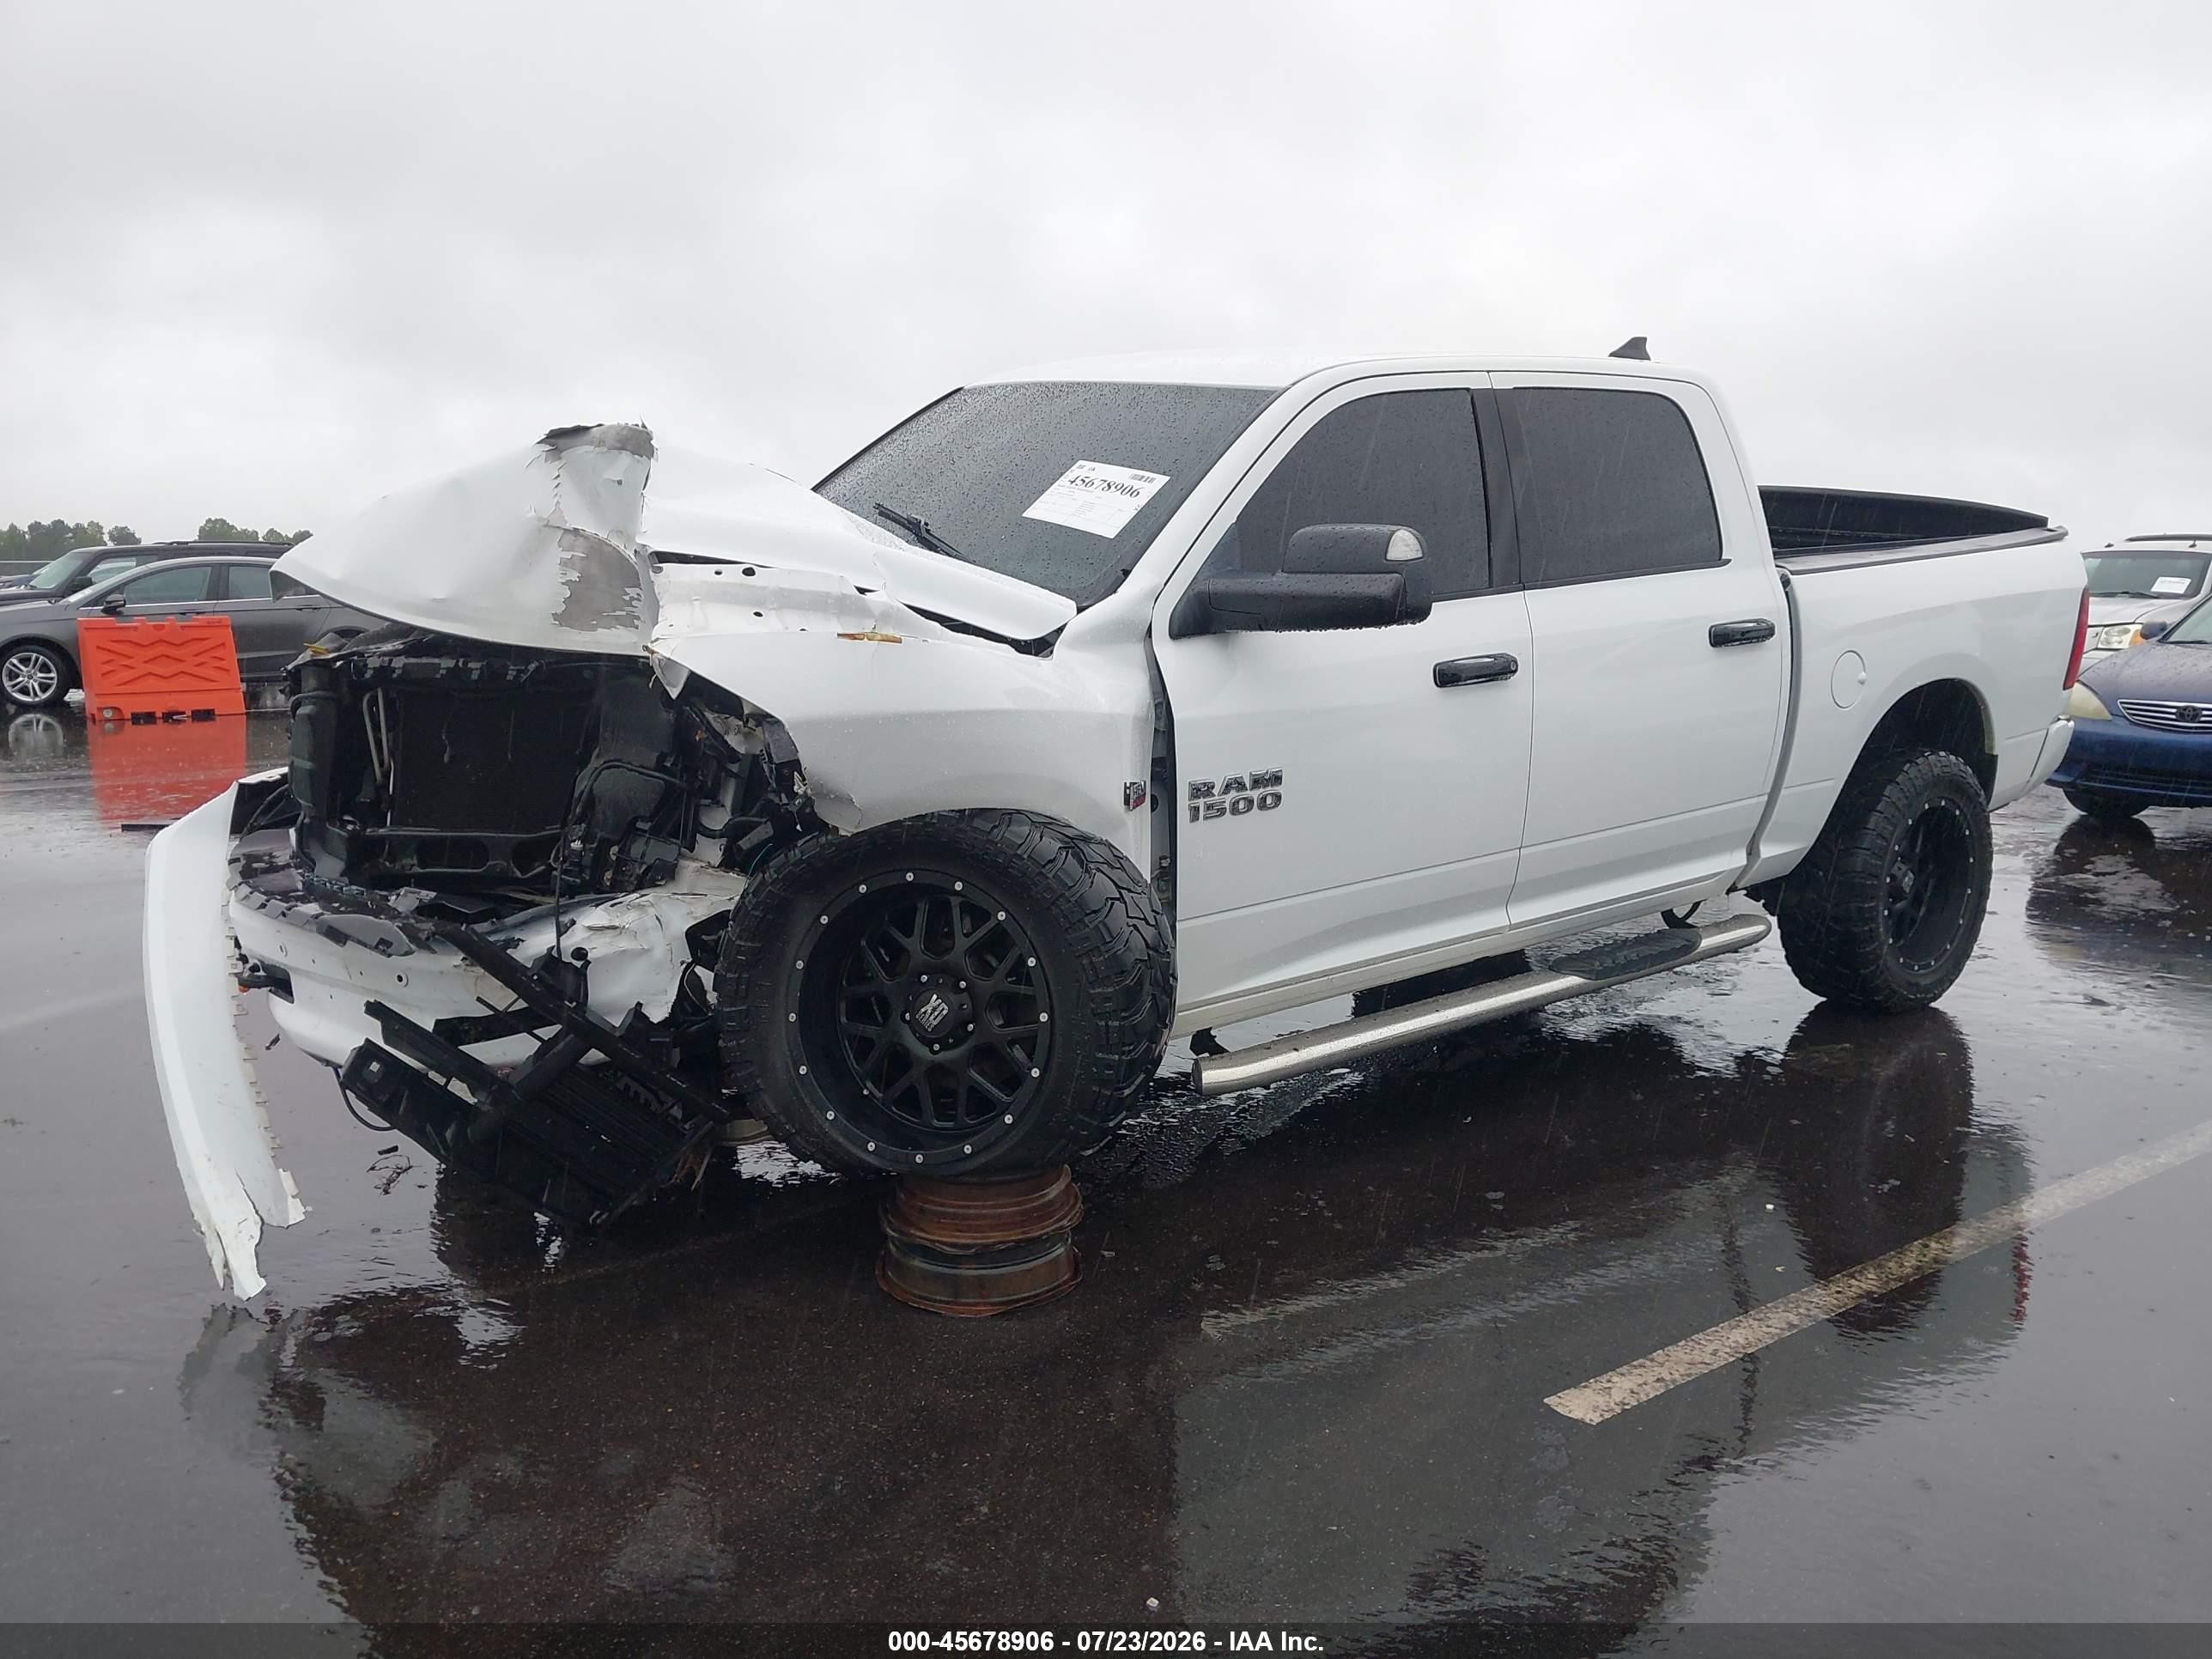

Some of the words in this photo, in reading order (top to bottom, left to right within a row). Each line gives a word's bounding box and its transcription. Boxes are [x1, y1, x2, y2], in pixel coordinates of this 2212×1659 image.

[1067, 474, 1145, 499] 45678906
[1188, 769, 1283, 801] RAM
[1188, 789, 1282, 823] 1500
[919, 994, 949, 1025] XD
